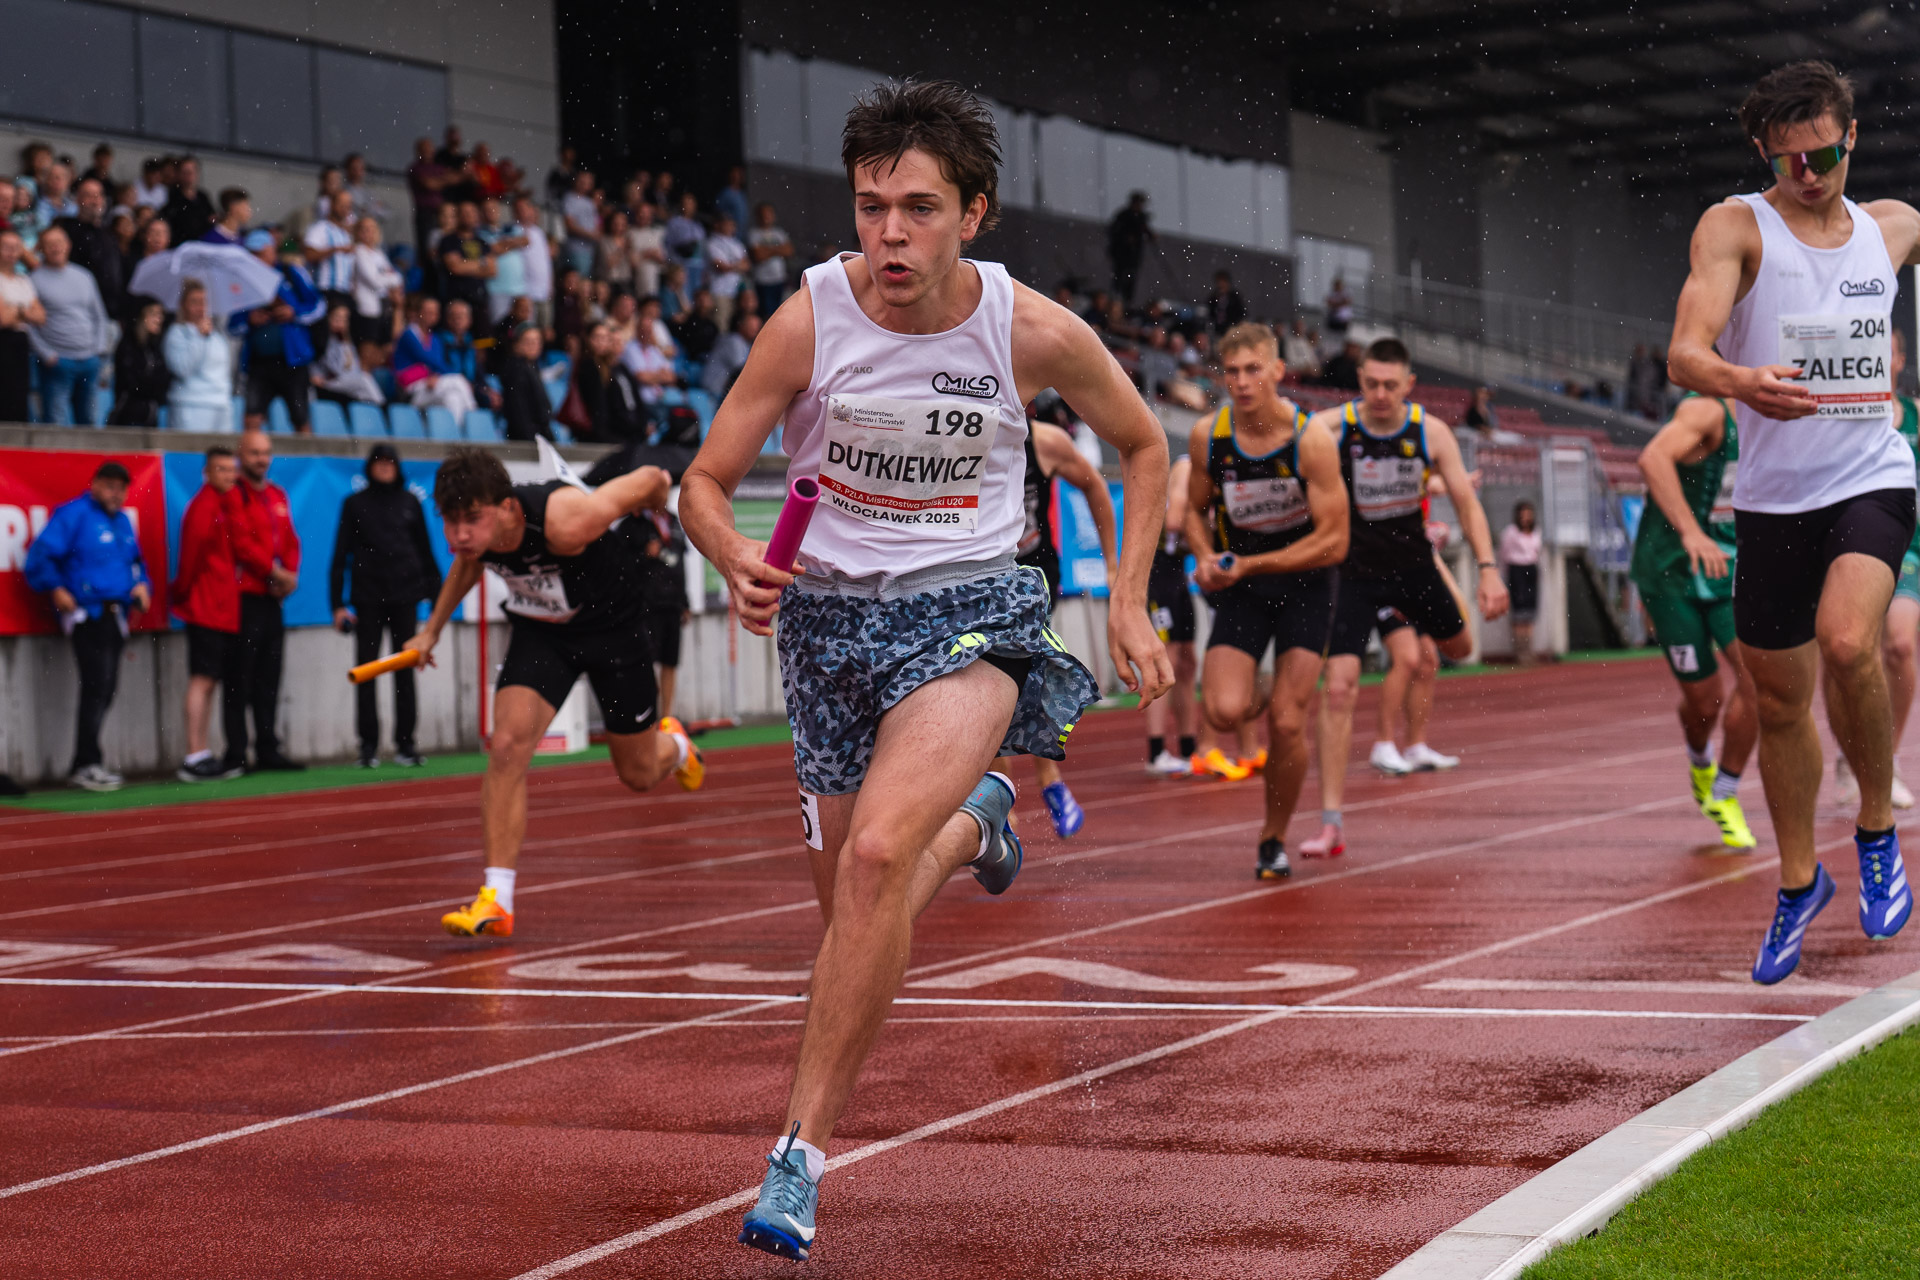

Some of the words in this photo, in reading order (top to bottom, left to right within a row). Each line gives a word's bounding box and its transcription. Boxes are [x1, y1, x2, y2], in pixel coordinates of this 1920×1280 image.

[1850, 318, 1885, 339] 204
[1792, 356, 1885, 381] ZALEGA
[853, 415, 874, 423] Sportu
[878, 417, 906, 426] Turystyki
[854, 408, 894, 418] Ministerstwo
[925, 409, 983, 438] 198
[1816, 406, 1865, 416] CŁAWEK
[827, 440, 983, 484] DUTKIEWICZ
[831, 481, 843, 493] 79.
[866, 495, 920, 509] Mistrzostwa
[921, 498, 945, 508] Polski
[946, 497, 964, 507] U20
[831, 494, 923, 524] WŁOCŁAWEK
[925, 512, 961, 524] 2025
